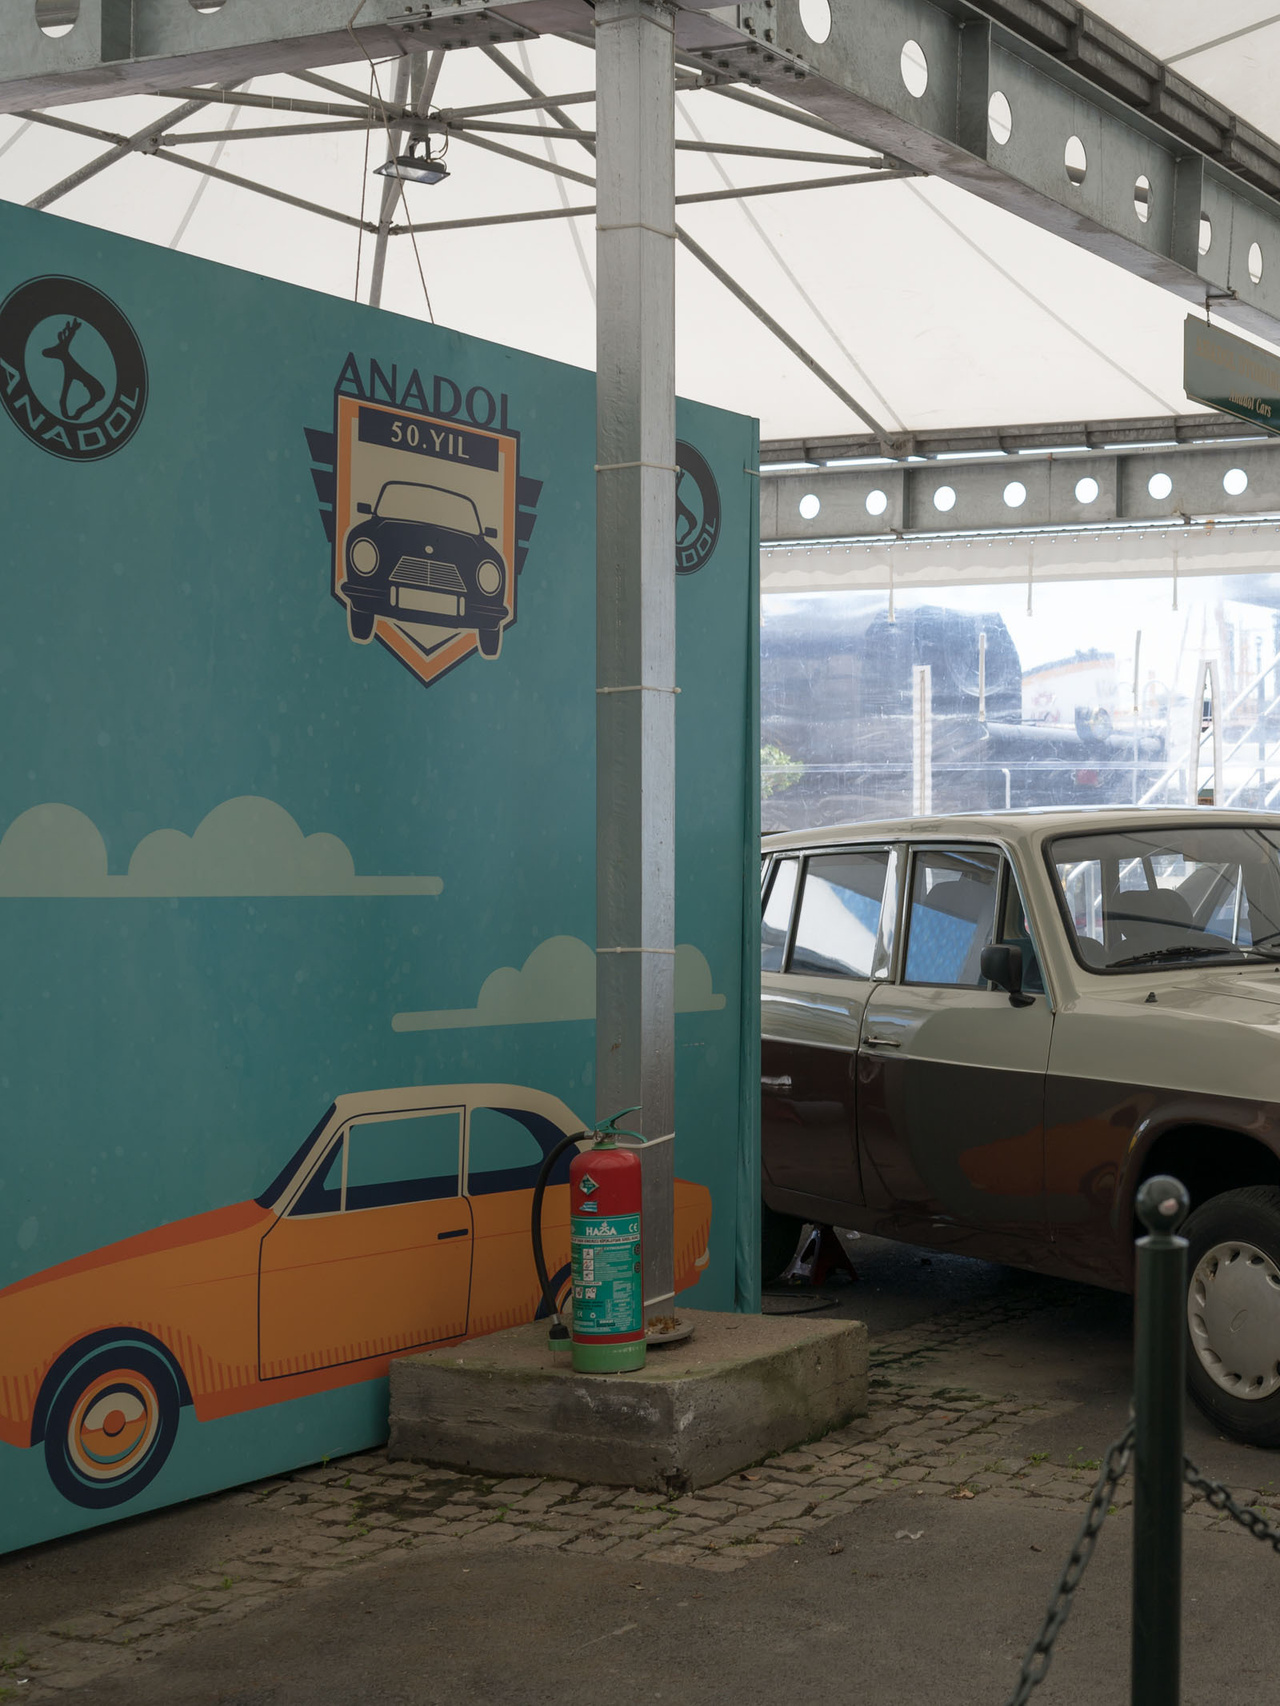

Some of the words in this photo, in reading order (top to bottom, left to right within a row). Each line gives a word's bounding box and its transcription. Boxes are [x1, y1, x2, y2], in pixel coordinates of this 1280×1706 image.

[0, 357, 140, 451] ANADOL
[1228, 389, 1256, 411] Anadol
[1255, 398, 1272, 418] Cars
[391, 421, 470, 459] 50.YIL
[676, 517, 717, 567] DOL
